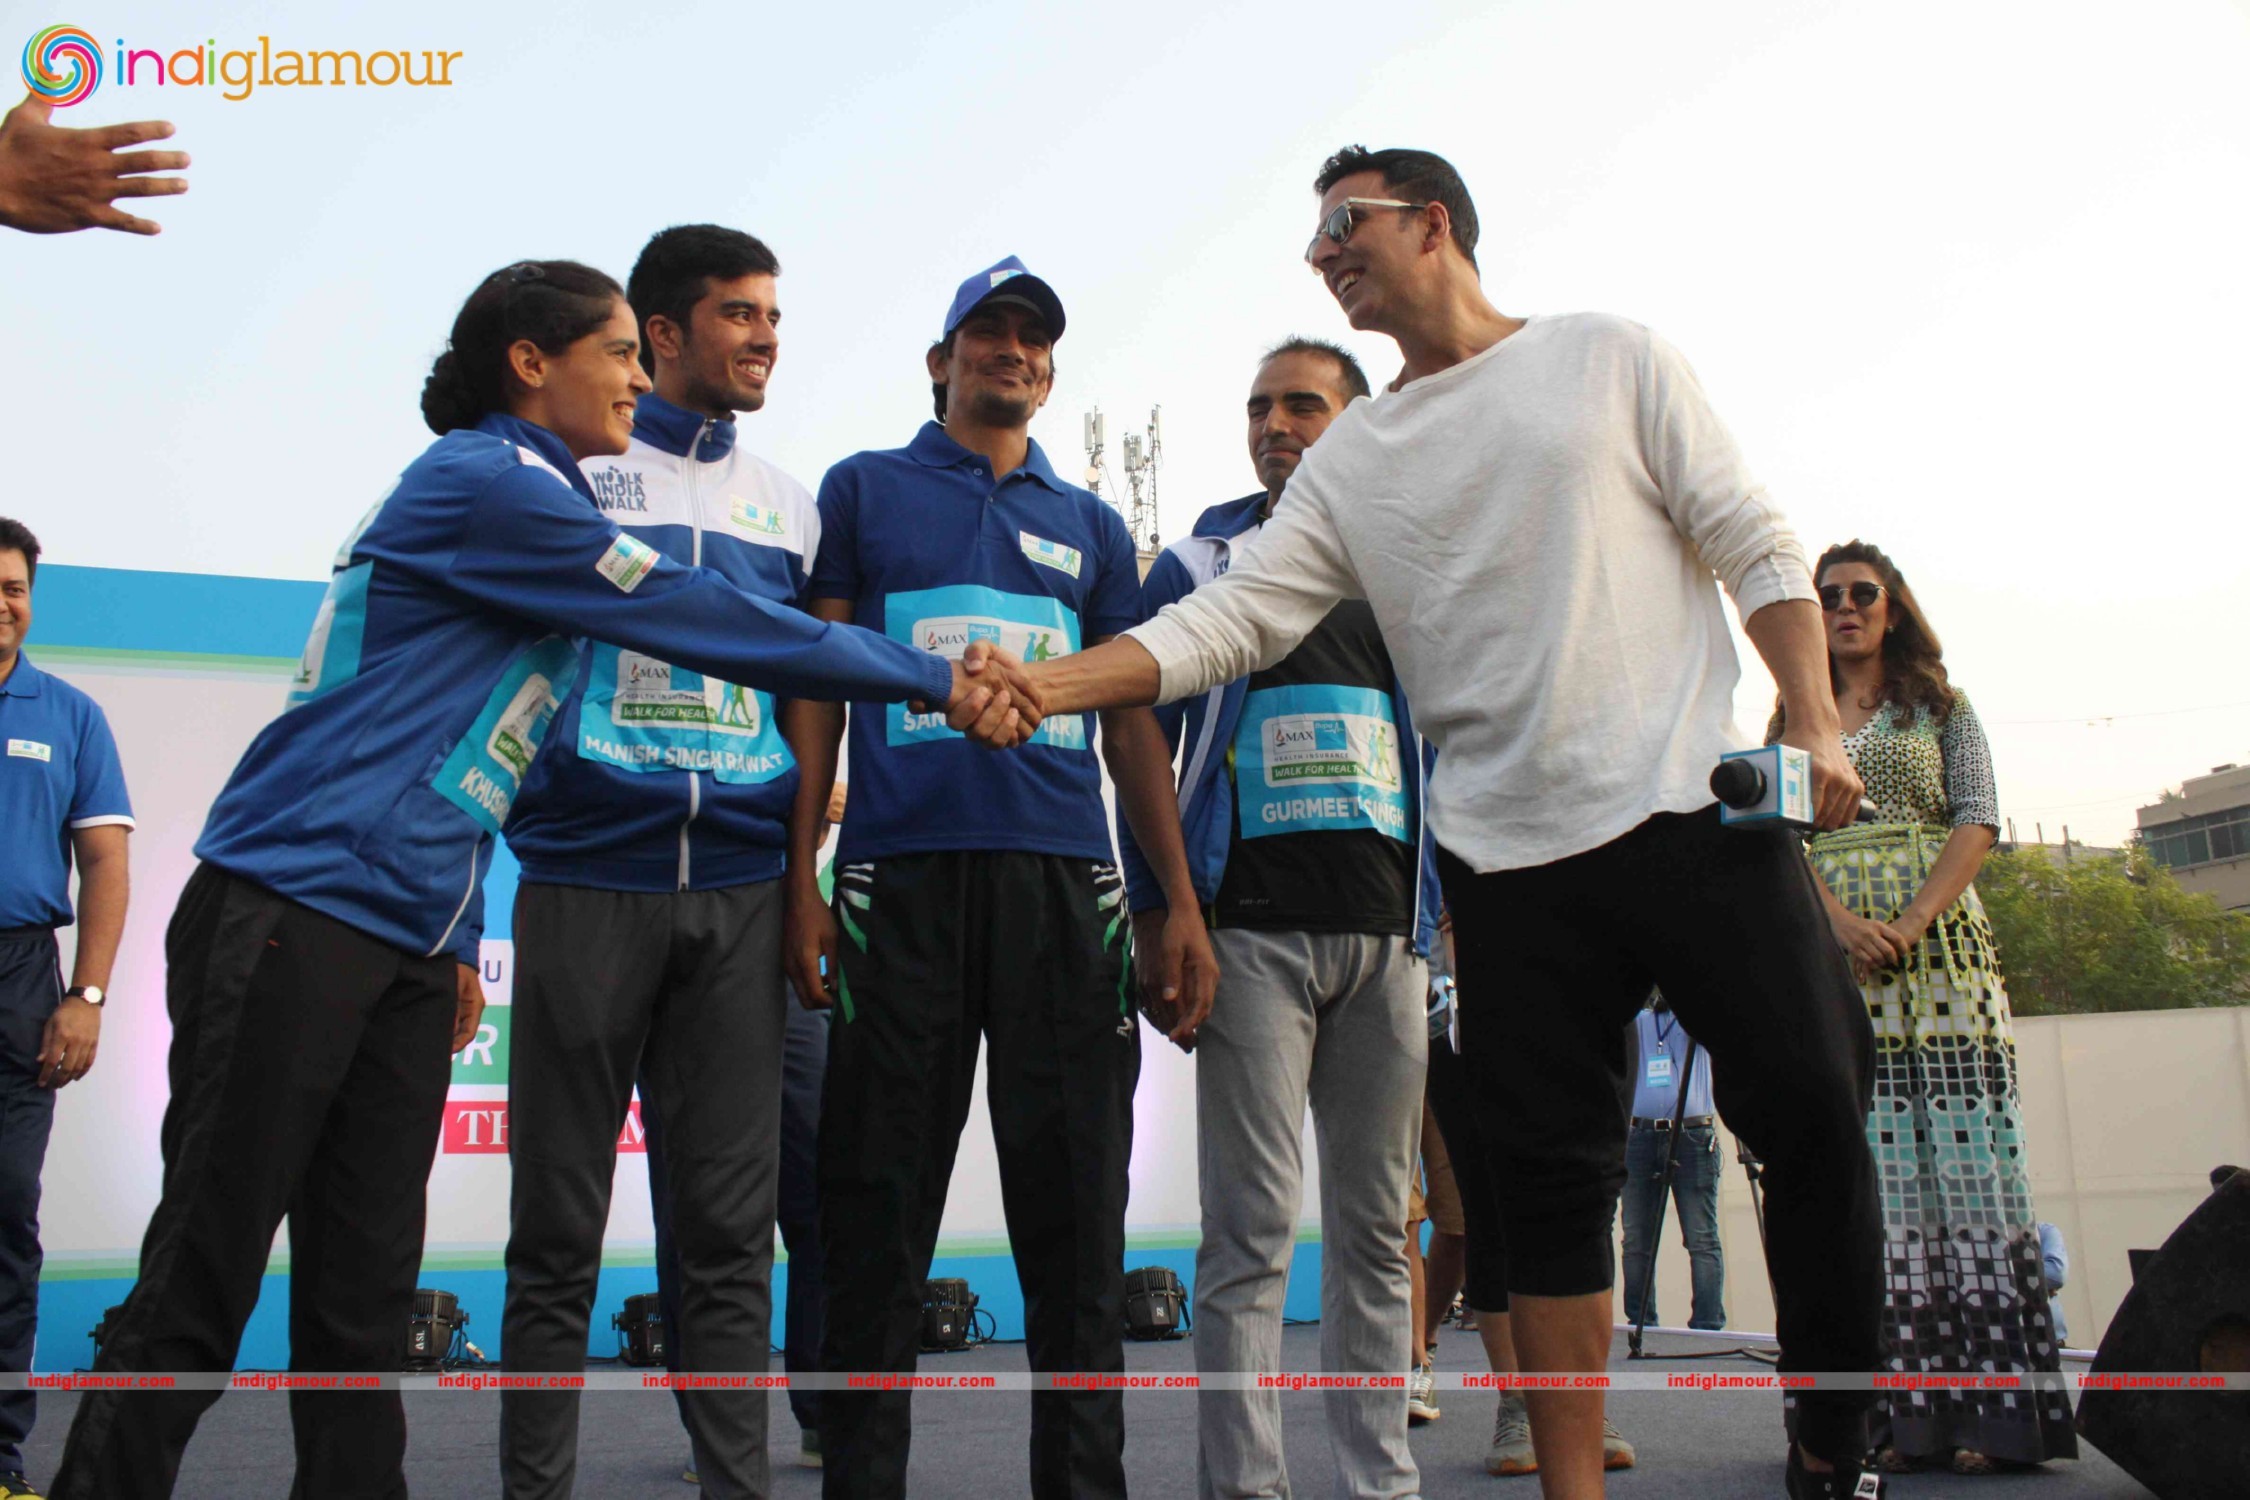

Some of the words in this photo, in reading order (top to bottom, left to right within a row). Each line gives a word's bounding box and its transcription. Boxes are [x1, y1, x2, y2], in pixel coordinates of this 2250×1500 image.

[596, 483, 646, 498] INDIA
[598, 496, 648, 512] WALK
[937, 634, 968, 646] MAX
[640, 667, 670, 679] MAX
[624, 705, 653, 717] WALK
[654, 707, 676, 717] FOR
[1285, 731, 1314, 742] MAX
[585, 735, 660, 764] MANISH
[665, 746, 722, 769] SINGH
[725, 752, 783, 773] RAWAT
[1274, 766, 1303, 778] WALK
[1304, 764, 1324, 775] FOR
[1261, 797, 1360, 823] GURMEET
[1364, 799, 1405, 830] SINGH
